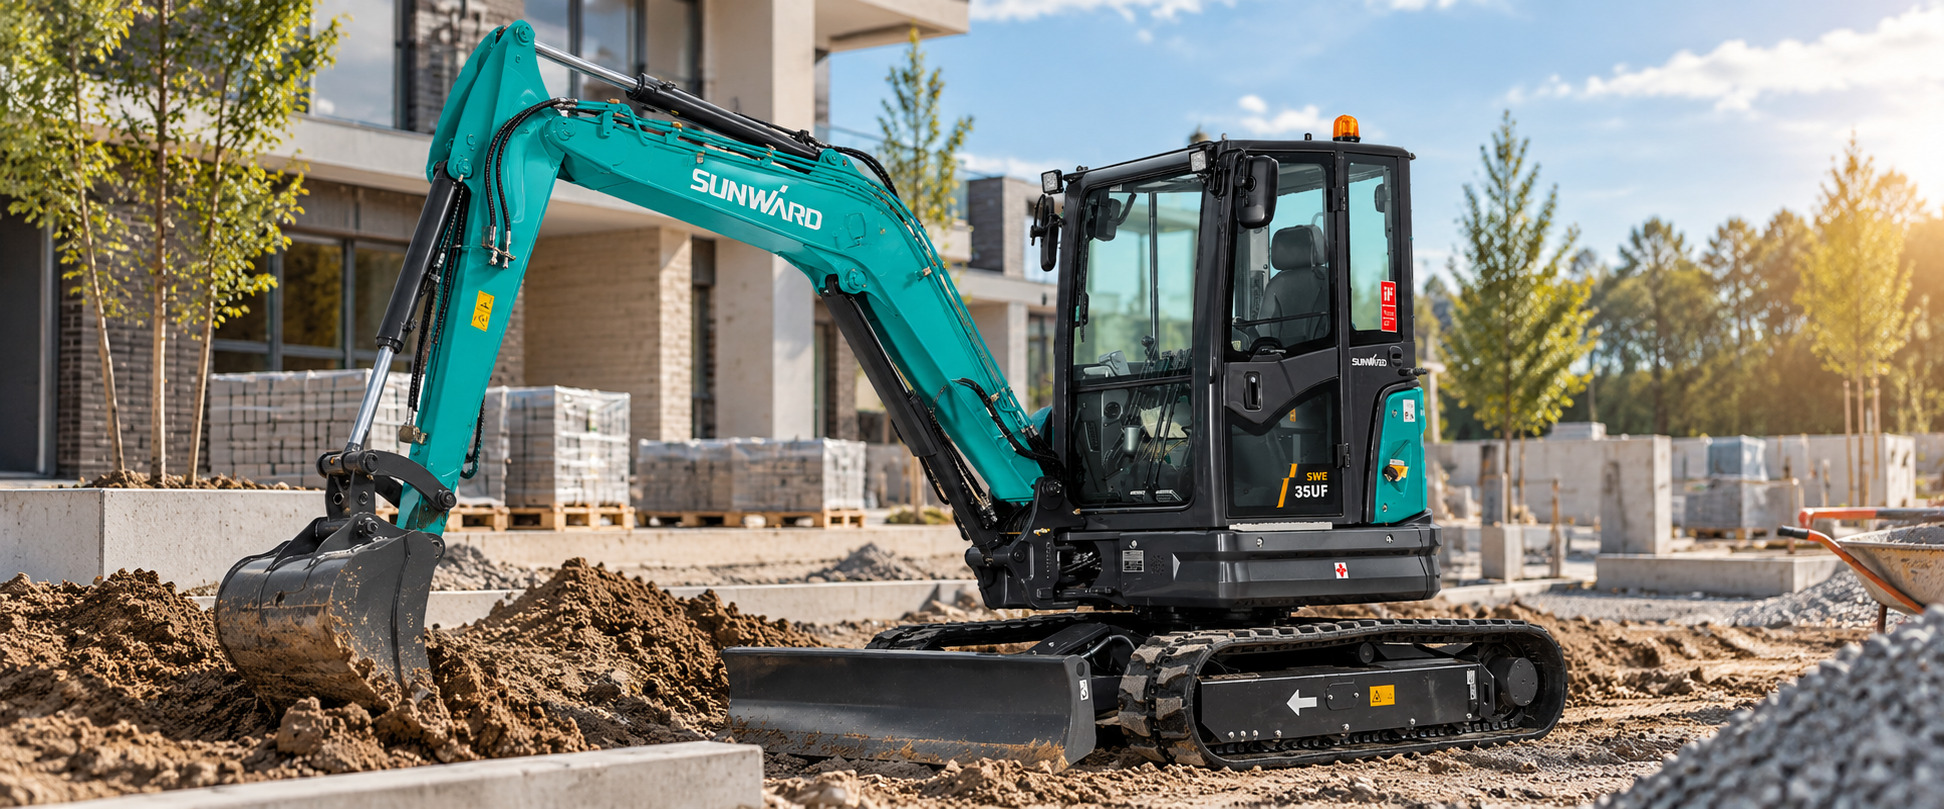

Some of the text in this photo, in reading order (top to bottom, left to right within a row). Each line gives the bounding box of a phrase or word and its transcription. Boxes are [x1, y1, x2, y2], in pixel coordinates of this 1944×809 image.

[690, 168, 823, 231] SUNWARD
[1306, 471, 1328, 482] SWE
[1294, 484, 1328, 499] 35UF
